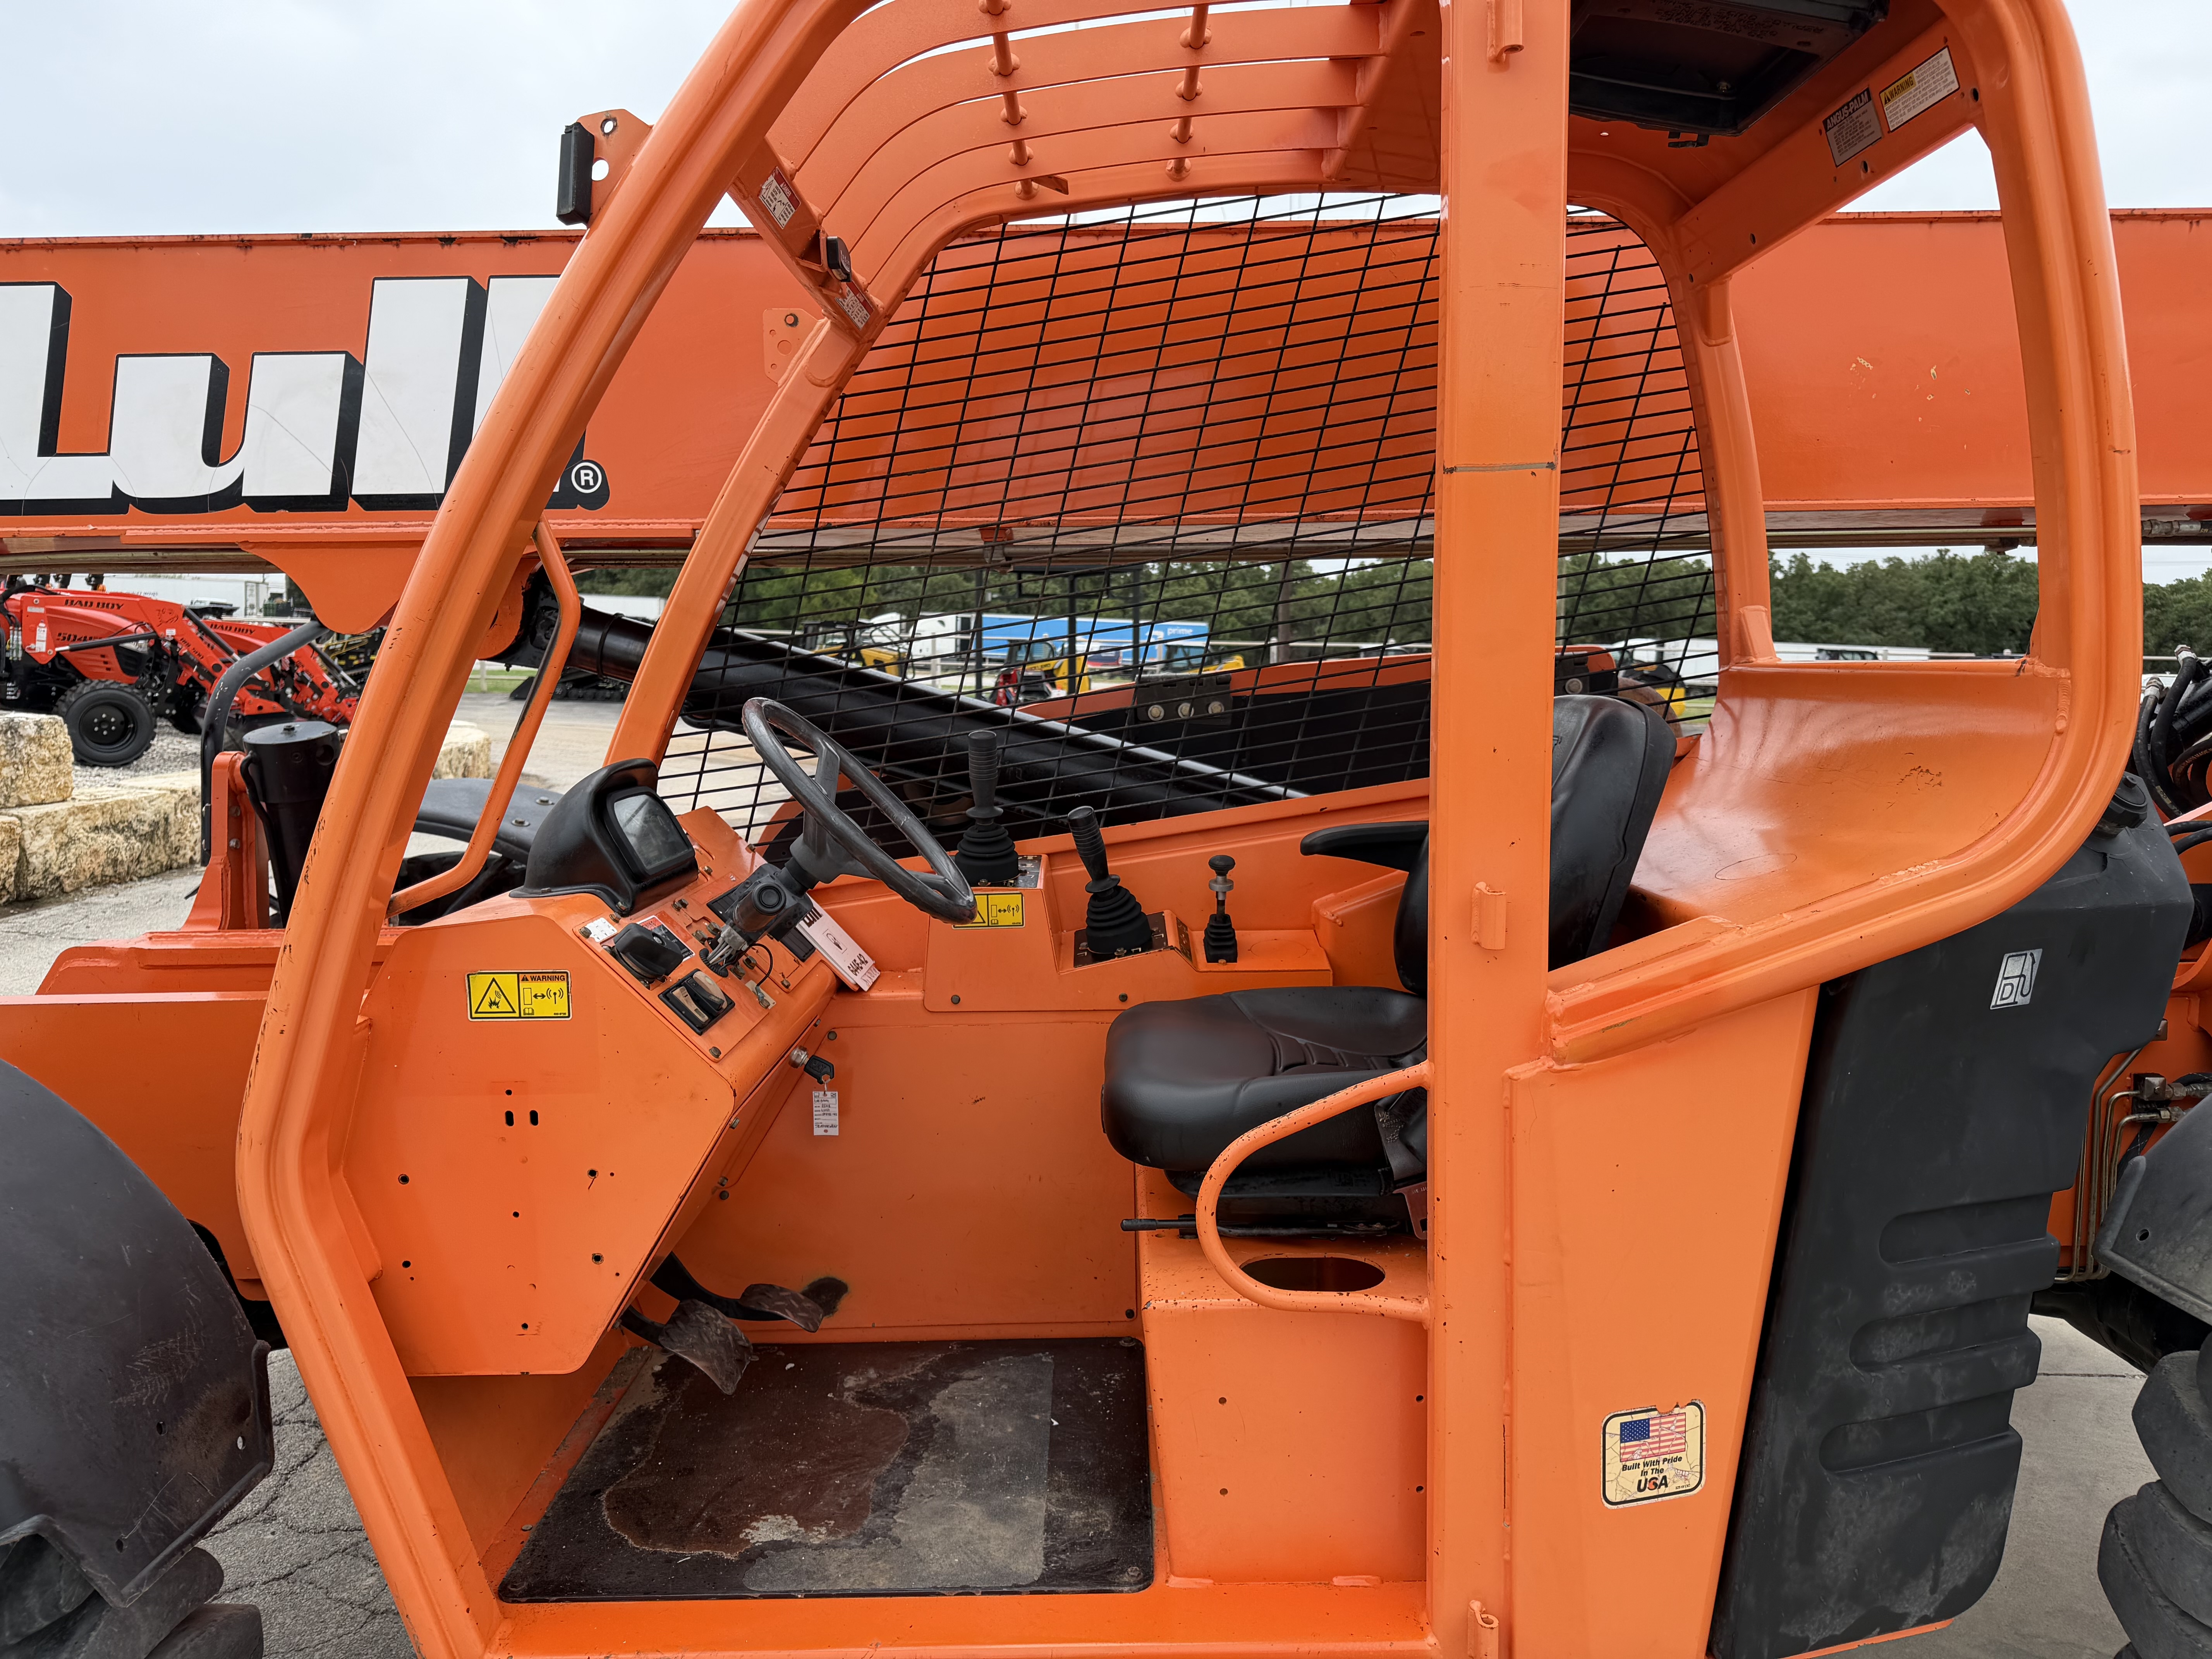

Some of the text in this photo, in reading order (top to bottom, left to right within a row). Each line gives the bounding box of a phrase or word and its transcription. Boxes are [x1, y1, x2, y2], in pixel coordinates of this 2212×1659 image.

[1889, 76, 1914, 100] WARNING
[1826, 91, 1869, 131] ANGUS-PALM
[64, 599, 124, 611] BAD BOY
[210, 623, 256, 635] BAD BOY
[1167, 626, 1193, 636] prime
[847, 953, 869, 976] 644E-42
[1622, 1455, 1683, 1472] Built With Pride
[1637, 1475, 1668, 1493] USA
